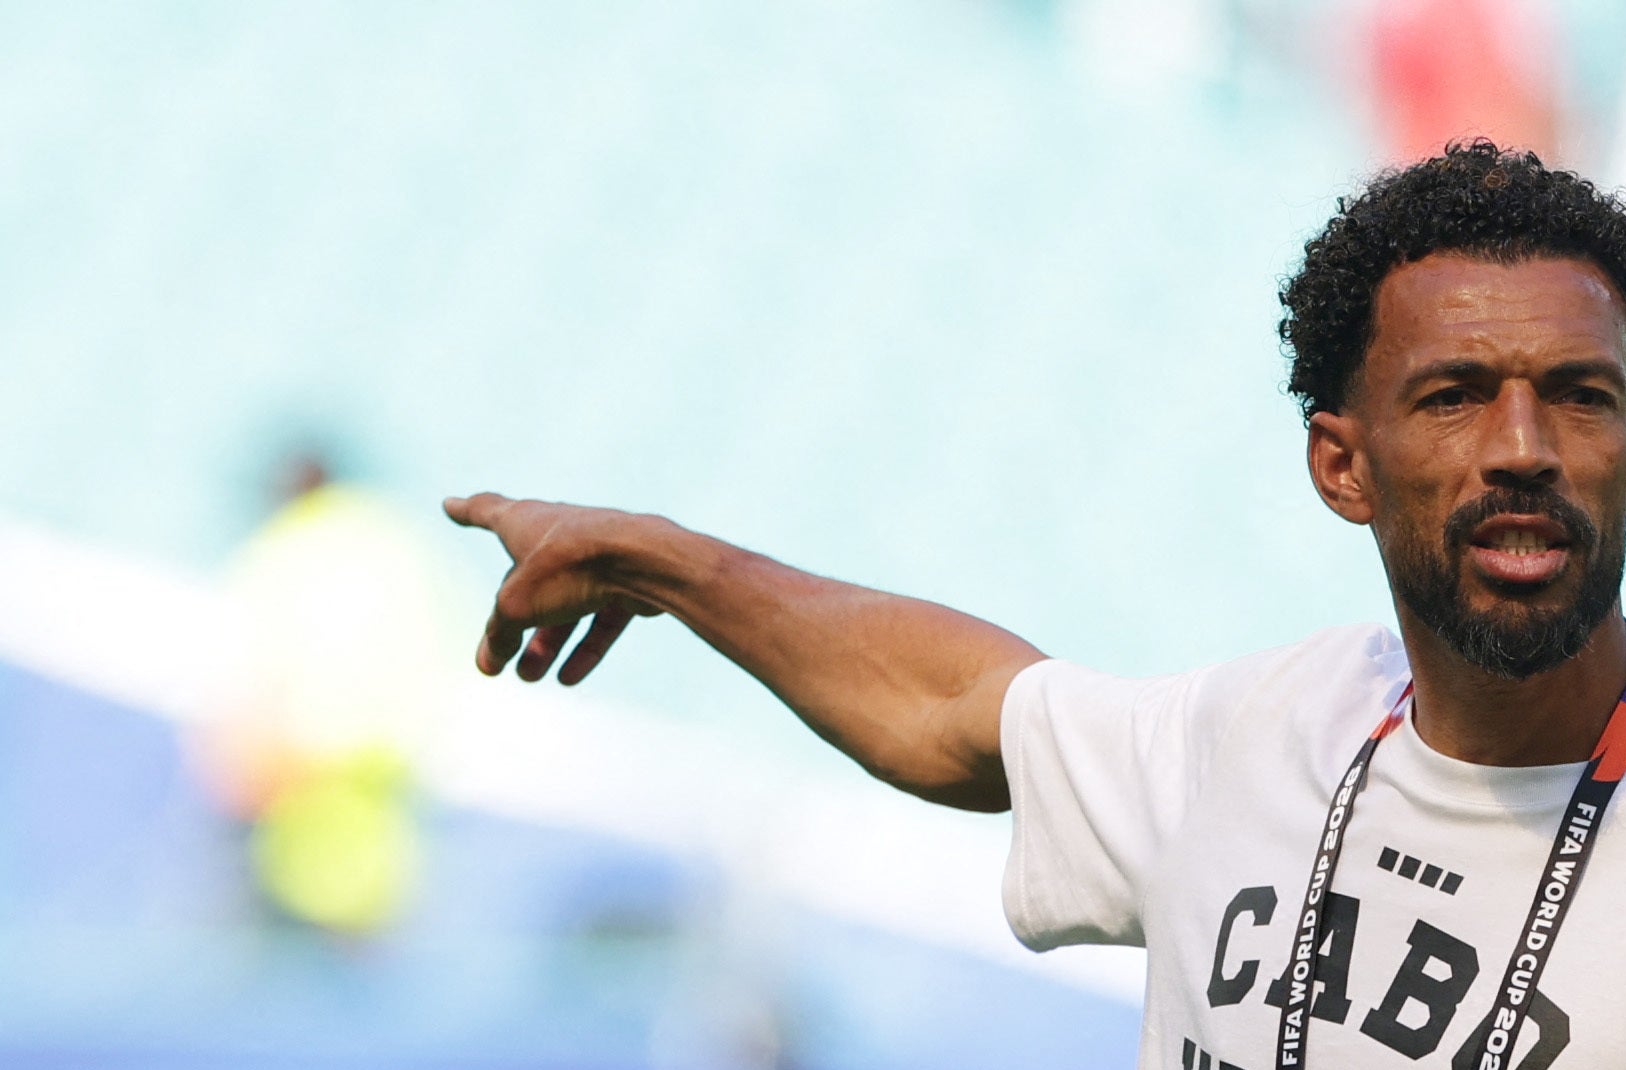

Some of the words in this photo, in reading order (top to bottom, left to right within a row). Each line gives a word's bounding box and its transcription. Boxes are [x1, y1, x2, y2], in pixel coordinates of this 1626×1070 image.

[1323, 762, 1363, 851] 2026
[1560, 802, 1597, 855] FIFA
[1308, 855, 1330, 904] CUP
[1526, 861, 1576, 950] WORLD
[1289, 908, 1317, 1004] WORLD
[1507, 954, 1538, 1006] CUP
[1282, 1008, 1304, 1065] FIFA
